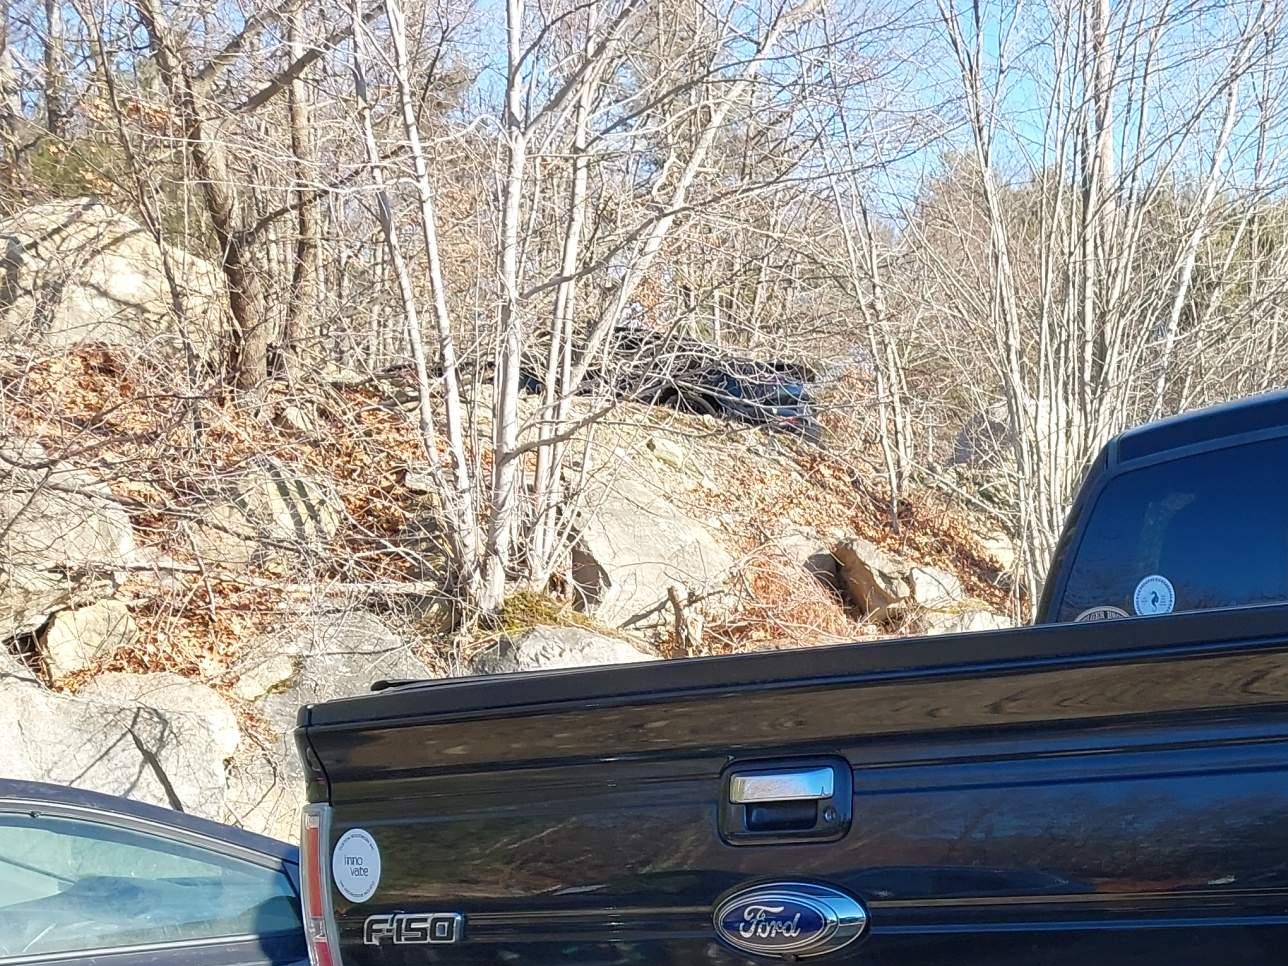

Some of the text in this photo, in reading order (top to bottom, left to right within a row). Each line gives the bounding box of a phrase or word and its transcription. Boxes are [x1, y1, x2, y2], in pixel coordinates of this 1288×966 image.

[350, 867, 369, 877] vate
[363, 912, 462, 946] F-150
[738, 905, 801, 938] Ford
